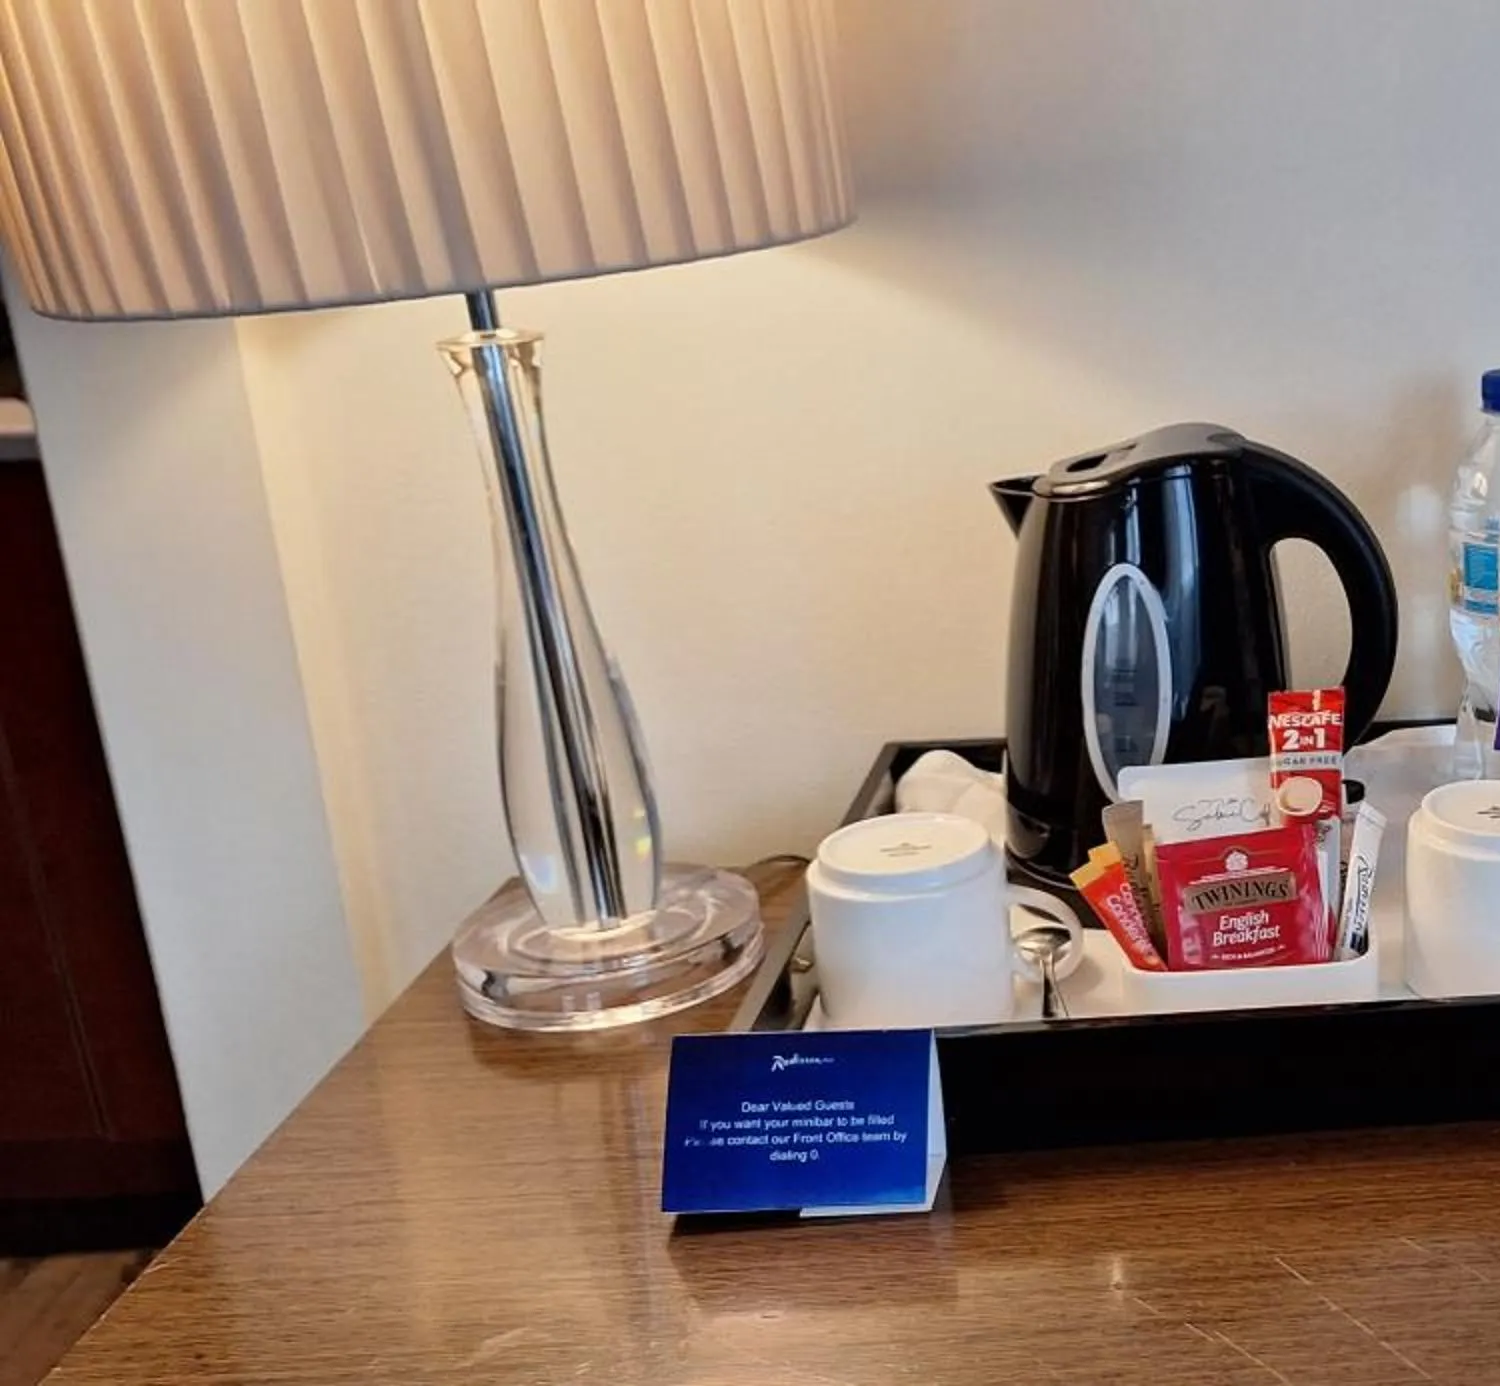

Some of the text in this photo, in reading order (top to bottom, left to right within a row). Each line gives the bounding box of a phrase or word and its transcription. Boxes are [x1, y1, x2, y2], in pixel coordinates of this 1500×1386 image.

[1193, 878, 1289, 911] TWININGS
[1219, 909, 1269, 931] English
[1213, 924, 1281, 948] Breakfast
[741, 1099, 855, 1113] Dear Valued Guests
[709, 1120, 732, 1132] you
[733, 1118, 761, 1129] want
[763, 1119, 789, 1131] your
[791, 1116, 834, 1128] minibar
[837, 1116, 849, 1127] to
[850, 1116, 865, 1127] be
[867, 1114, 895, 1126] filled
[727, 1134, 769, 1146] contact
[771, 1135, 791, 1145] our
[792, 1132, 824, 1144] Front
[825, 1131, 860, 1144] Office
[861, 1131, 892, 1143] team
[892, 1130, 908, 1144] by
[769, 1150, 808, 1163] dialing
